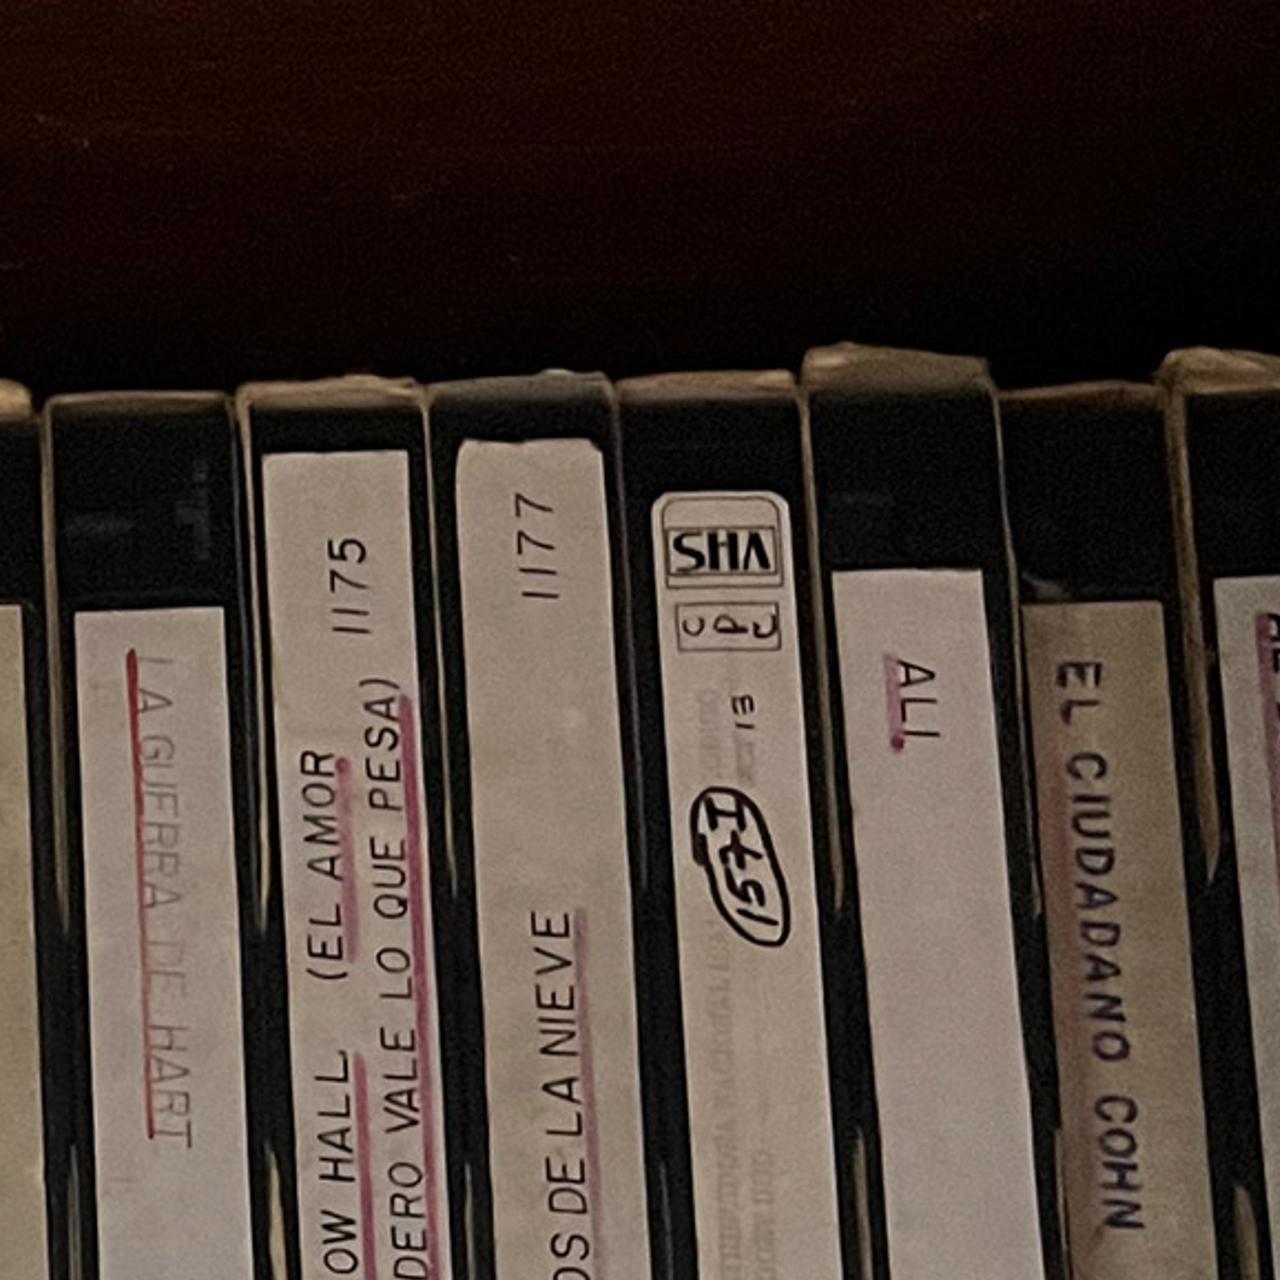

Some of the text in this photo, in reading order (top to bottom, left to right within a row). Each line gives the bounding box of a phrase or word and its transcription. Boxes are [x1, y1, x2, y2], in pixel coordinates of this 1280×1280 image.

[327, 537, 371, 635] 1175
[514, 492, 560, 600] 1177
[672, 531, 771, 574] VHS
[359, 678, 403, 811] PESA)
[899, 659, 942, 740] ALI
[299, 749, 349, 981] (EL AMOR
[371, 836, 410, 920] QUE
[375, 945, 414, 1002] LO
[531, 910, 579, 1058] NIEVE
[1056, 660, 1146, 1233] EL CIUDADANO COHN
[146, 1024, 194, 1149] HART
[315, 1050, 356, 1183] HALL
[379, 1026, 422, 1134] VALE
[543, 1075, 583, 1136] LA
[546, 1156, 589, 1216] DE
